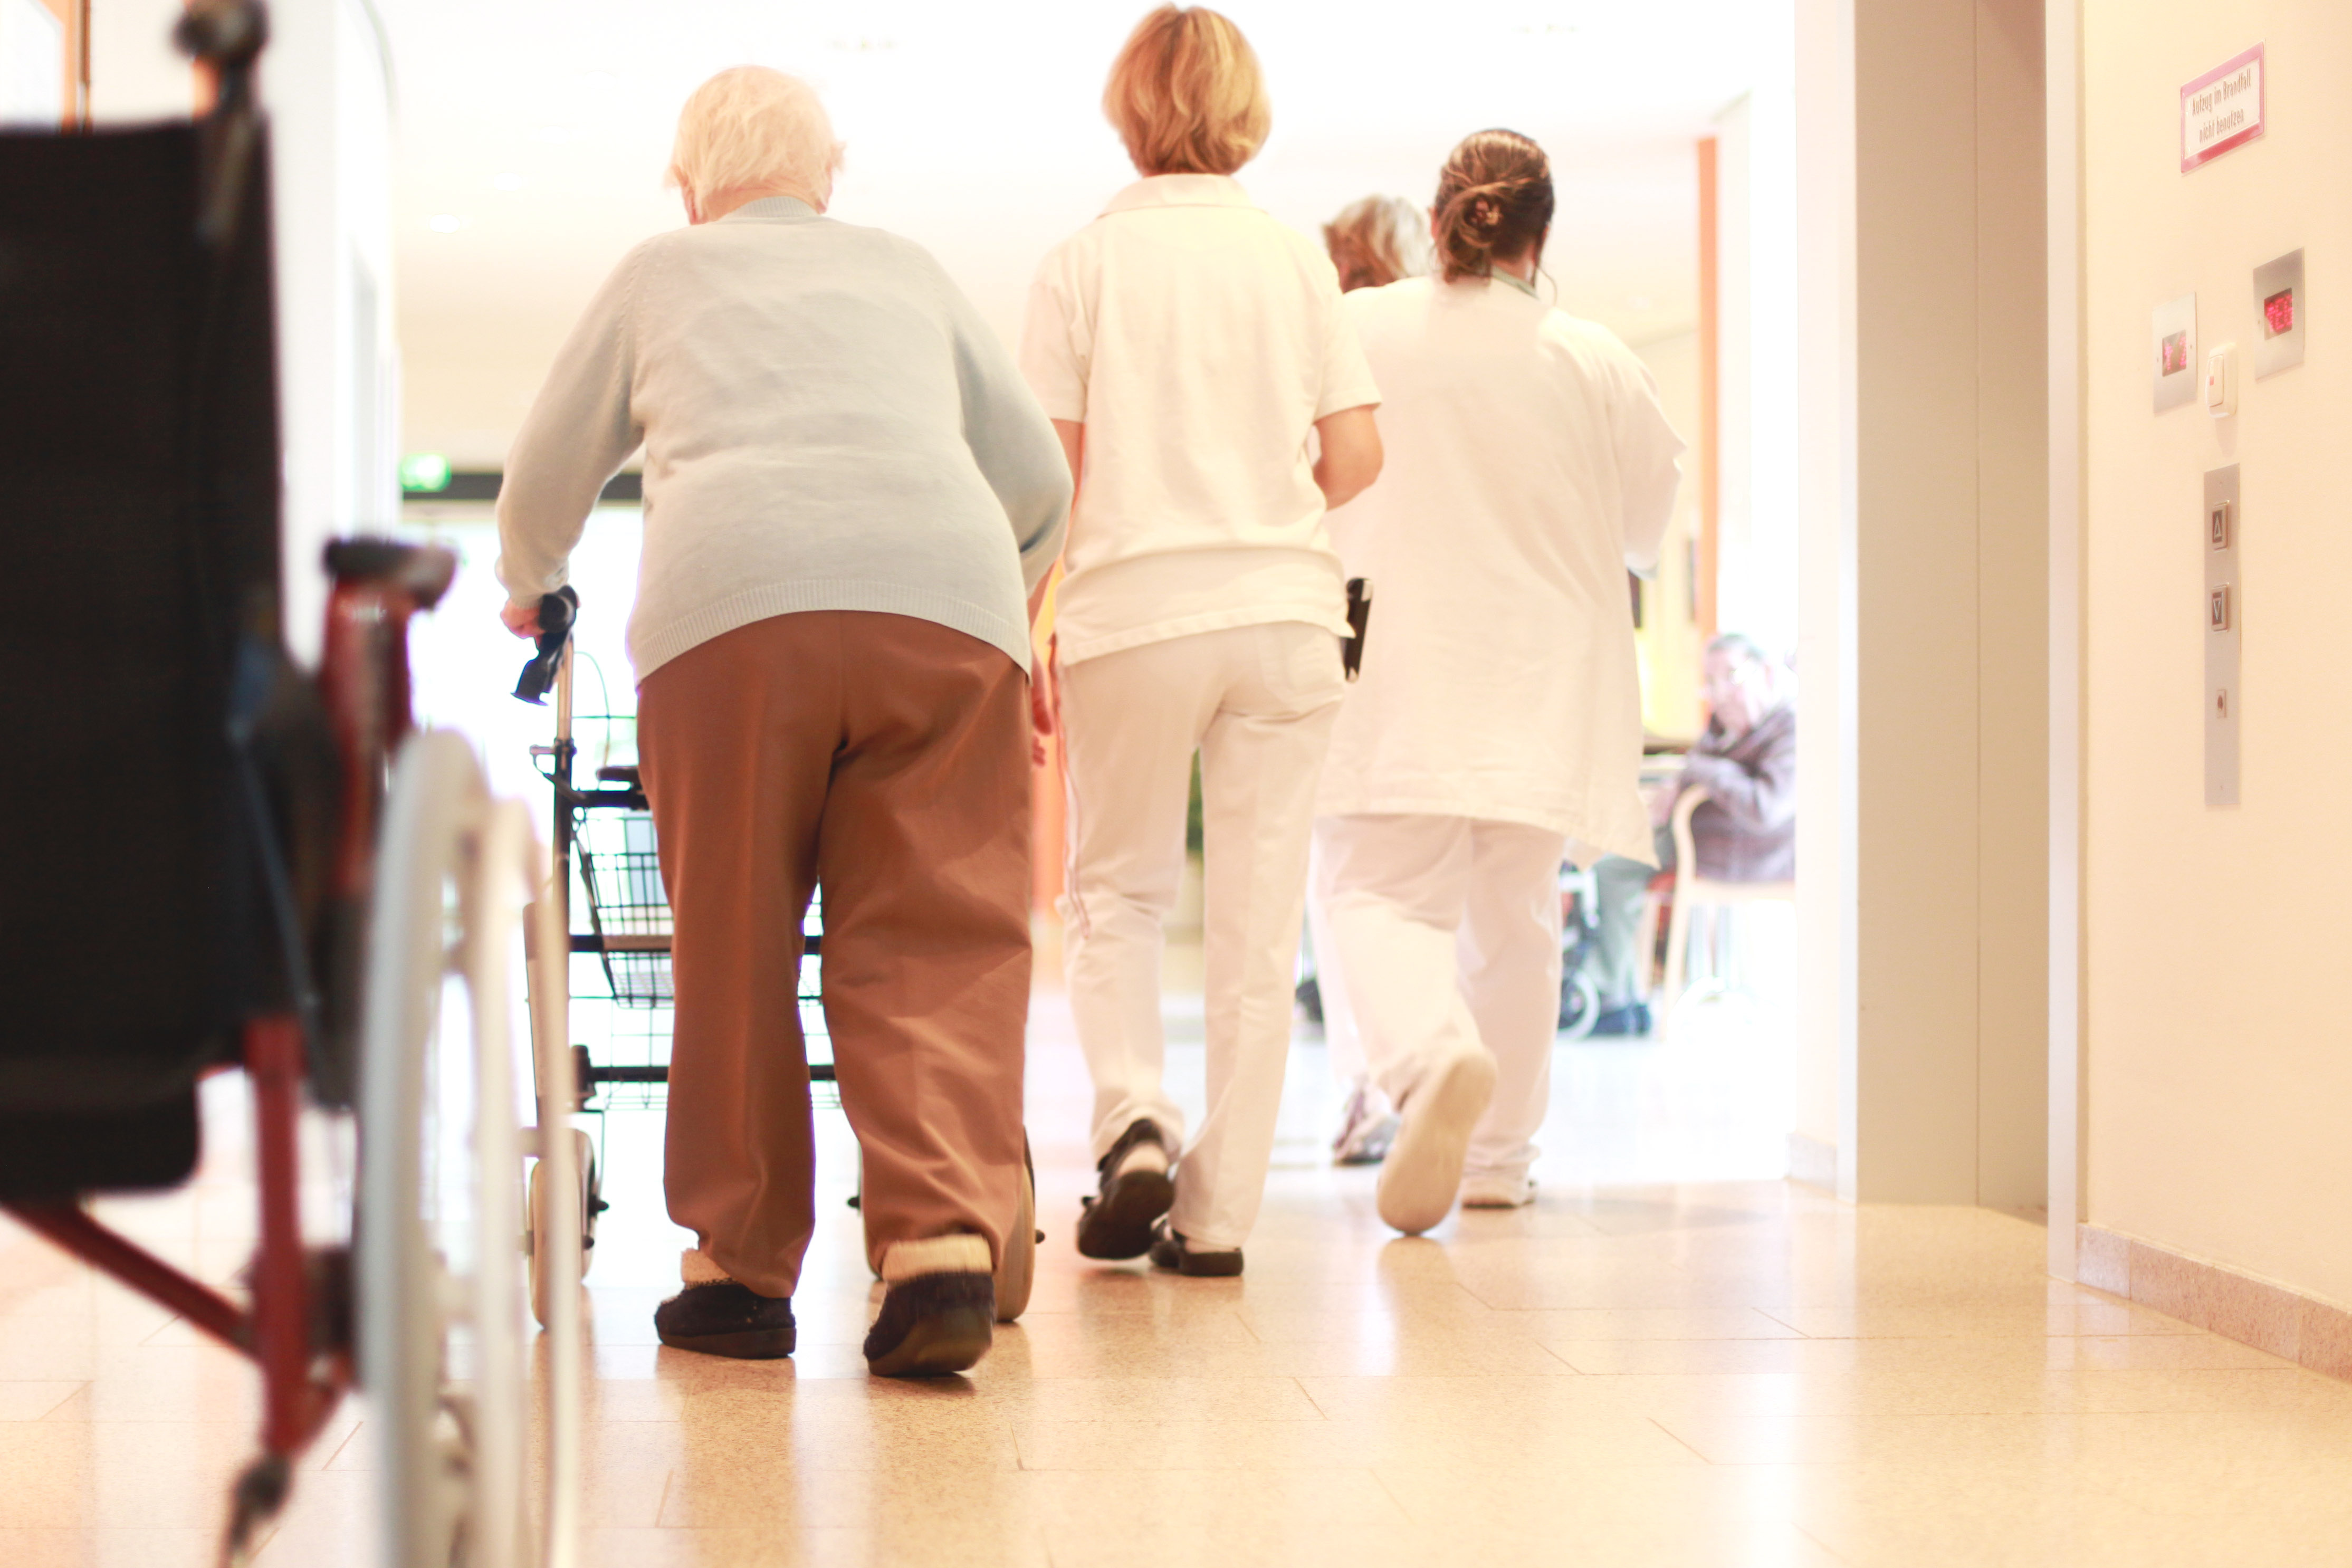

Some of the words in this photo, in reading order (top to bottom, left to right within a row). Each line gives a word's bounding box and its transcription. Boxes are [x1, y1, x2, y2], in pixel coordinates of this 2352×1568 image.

[2192, 93, 2212, 117] Aufzug
[2214, 86, 2221, 103] im
[2223, 68, 2251, 101] Brandfall
[2199, 120, 2214, 144] nicht
[2216, 108, 2244, 134] benutzen
